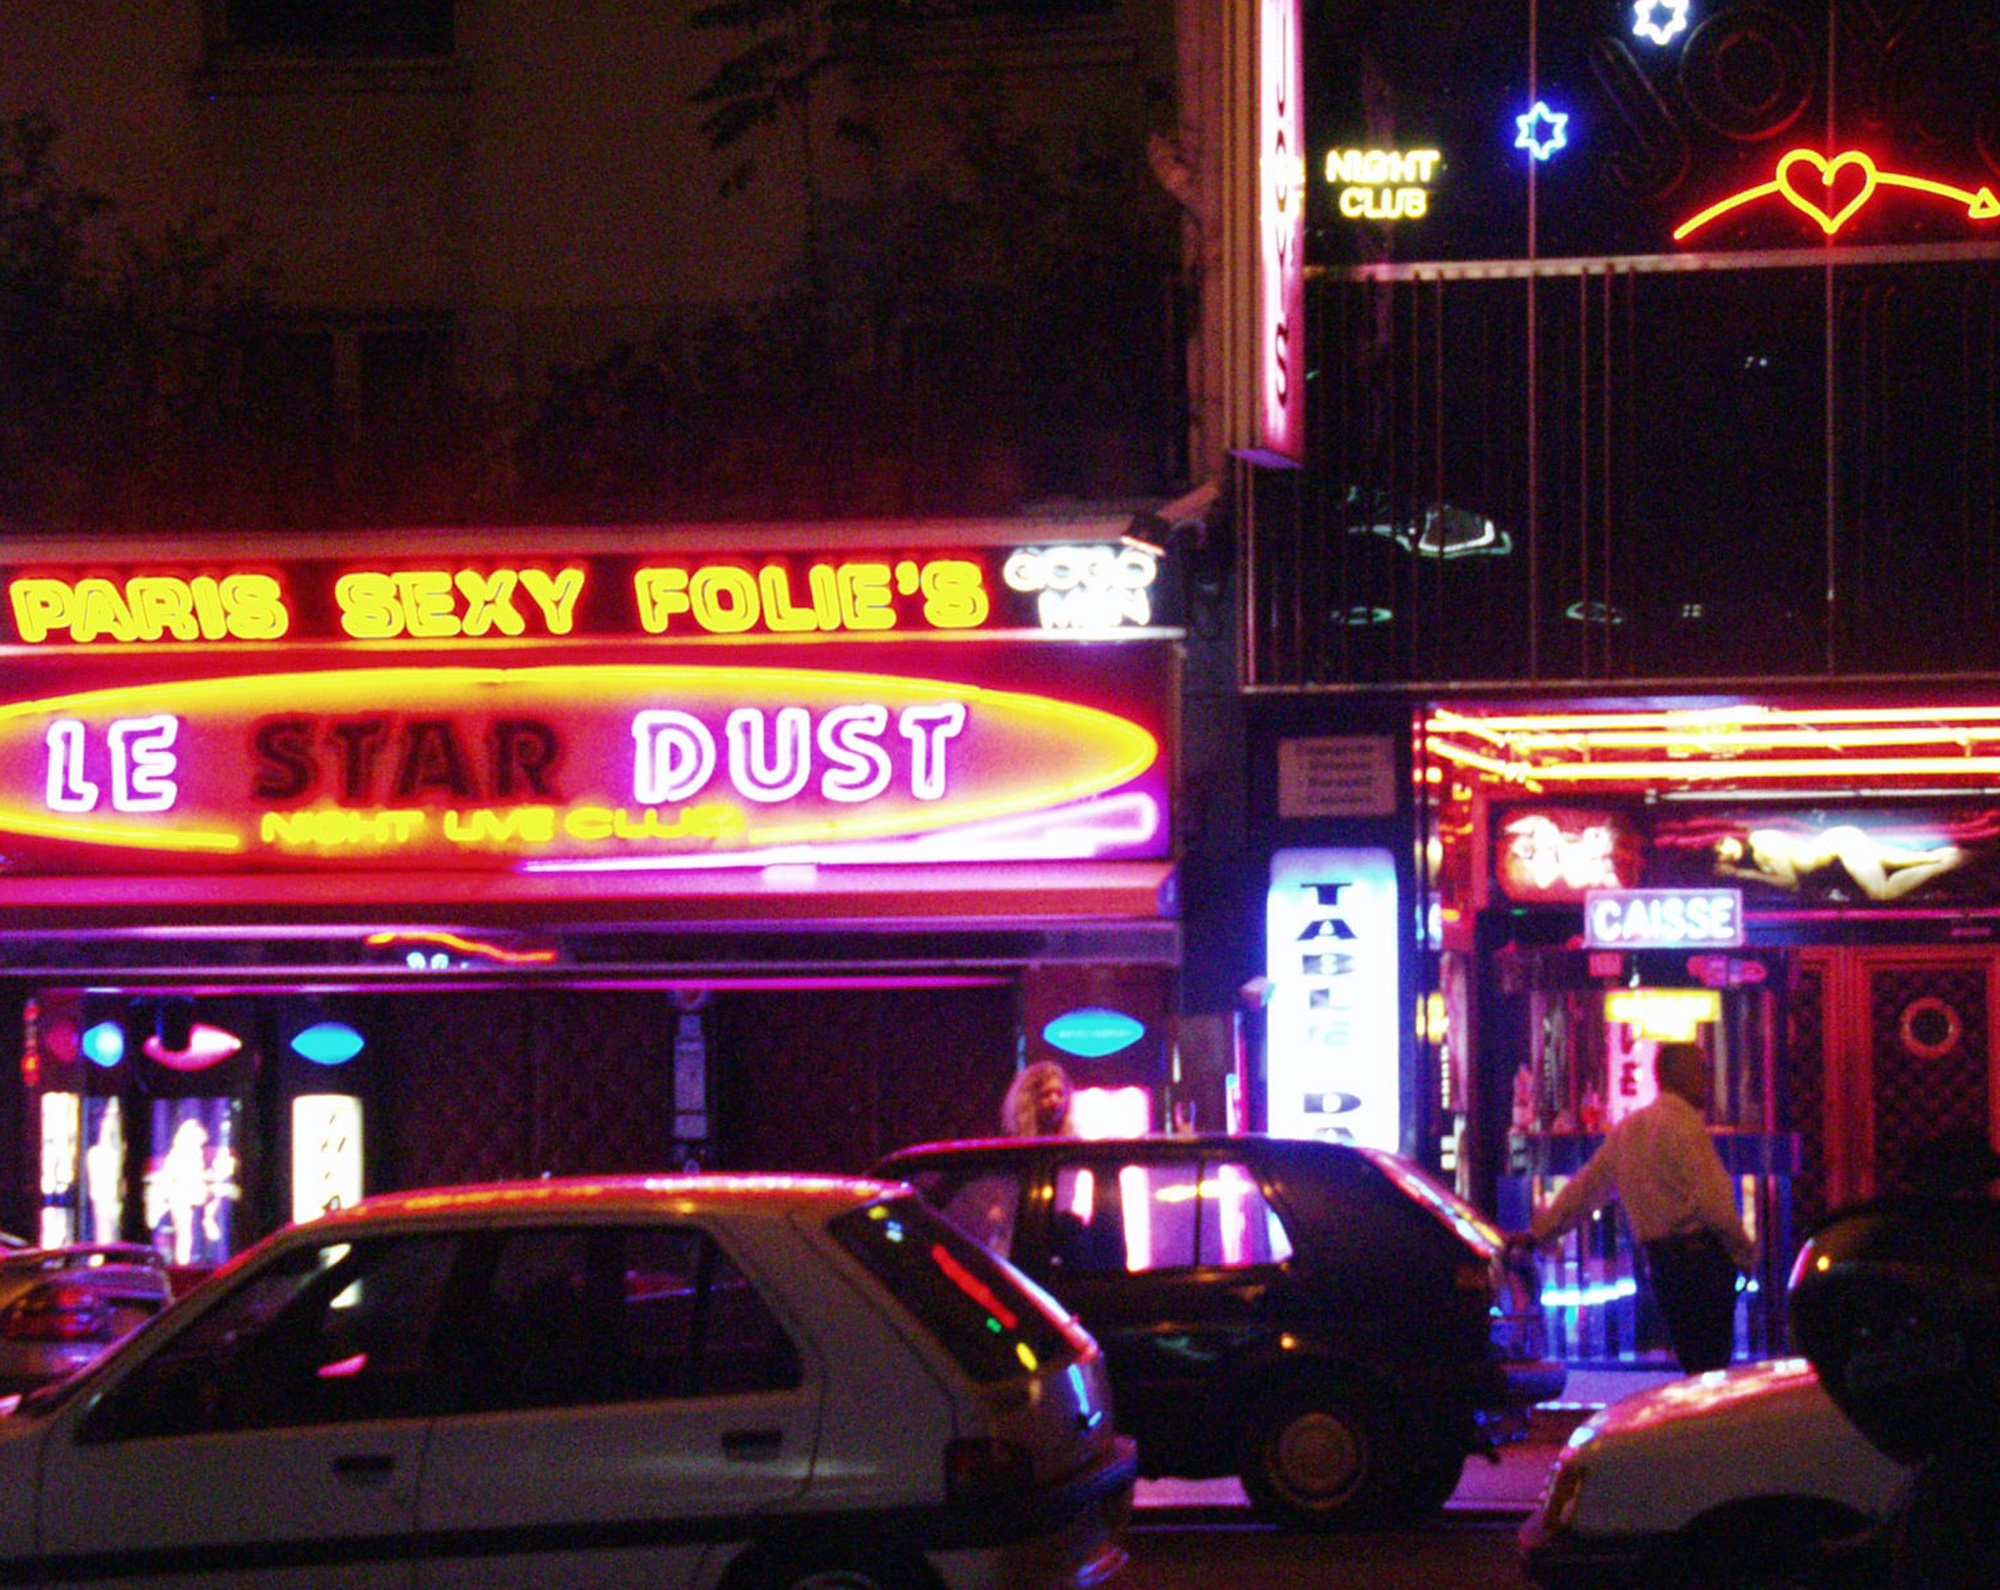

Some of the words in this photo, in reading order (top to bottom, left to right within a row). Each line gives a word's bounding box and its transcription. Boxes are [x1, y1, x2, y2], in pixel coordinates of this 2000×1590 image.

[1326, 150, 1440, 182] NIGHT
[1340, 188, 1428, 218] CLUB
[10, 574, 289, 643] PARIS
[335, 568, 585, 639] SEXY
[634, 560, 989, 634] FOLIE'S
[46, 714, 178, 813] LE
[250, 716, 560, 803] STAR
[632, 702, 966, 804] DUST
[261, 810, 425, 845] NIGHT
[443, 807, 555, 843] LIVE
[564, 806, 746, 841] CLUB
[1592, 896, 1736, 943] CAISSE
[1296, 882, 1359, 1047] TABLE
